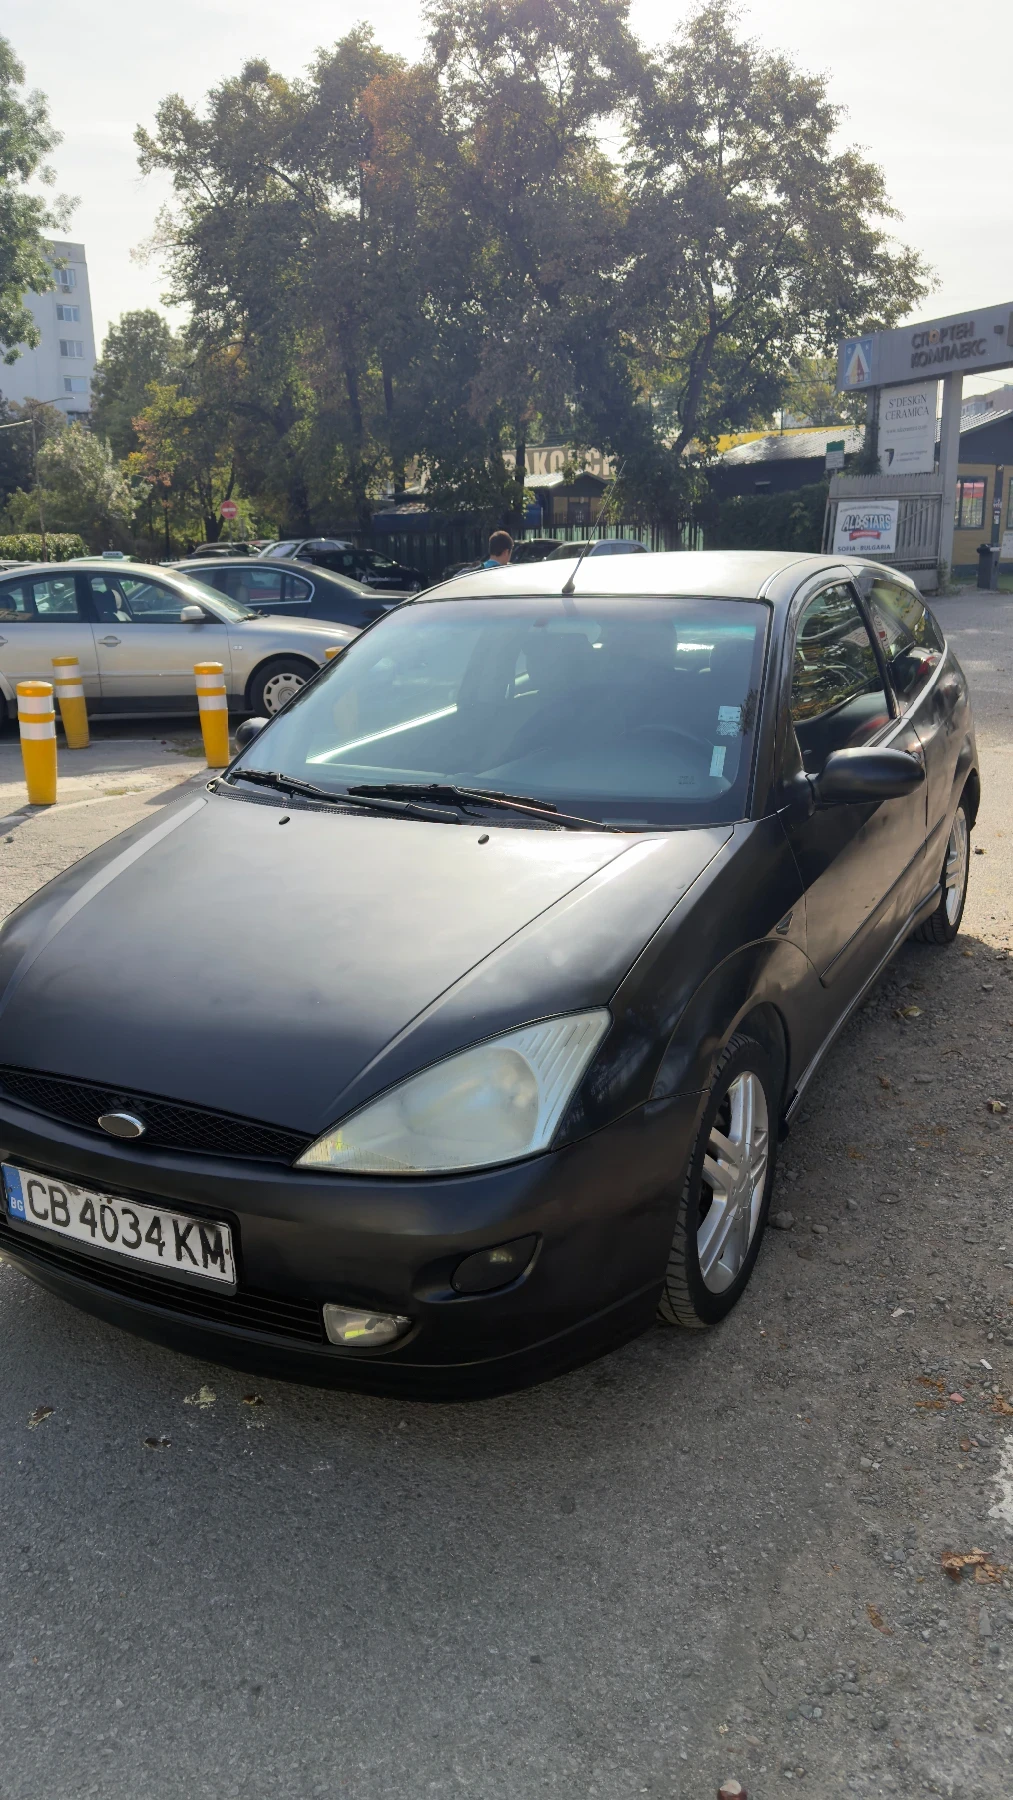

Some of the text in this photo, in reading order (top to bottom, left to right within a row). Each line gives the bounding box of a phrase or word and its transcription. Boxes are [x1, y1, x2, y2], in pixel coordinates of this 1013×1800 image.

[911, 338, 987, 368] КОМПЛЕКС
[885, 406, 930, 421] CERAMICA
[11, 1196, 24, 1212] BG
[27, 1179, 226, 1274] CB 4034 KM
